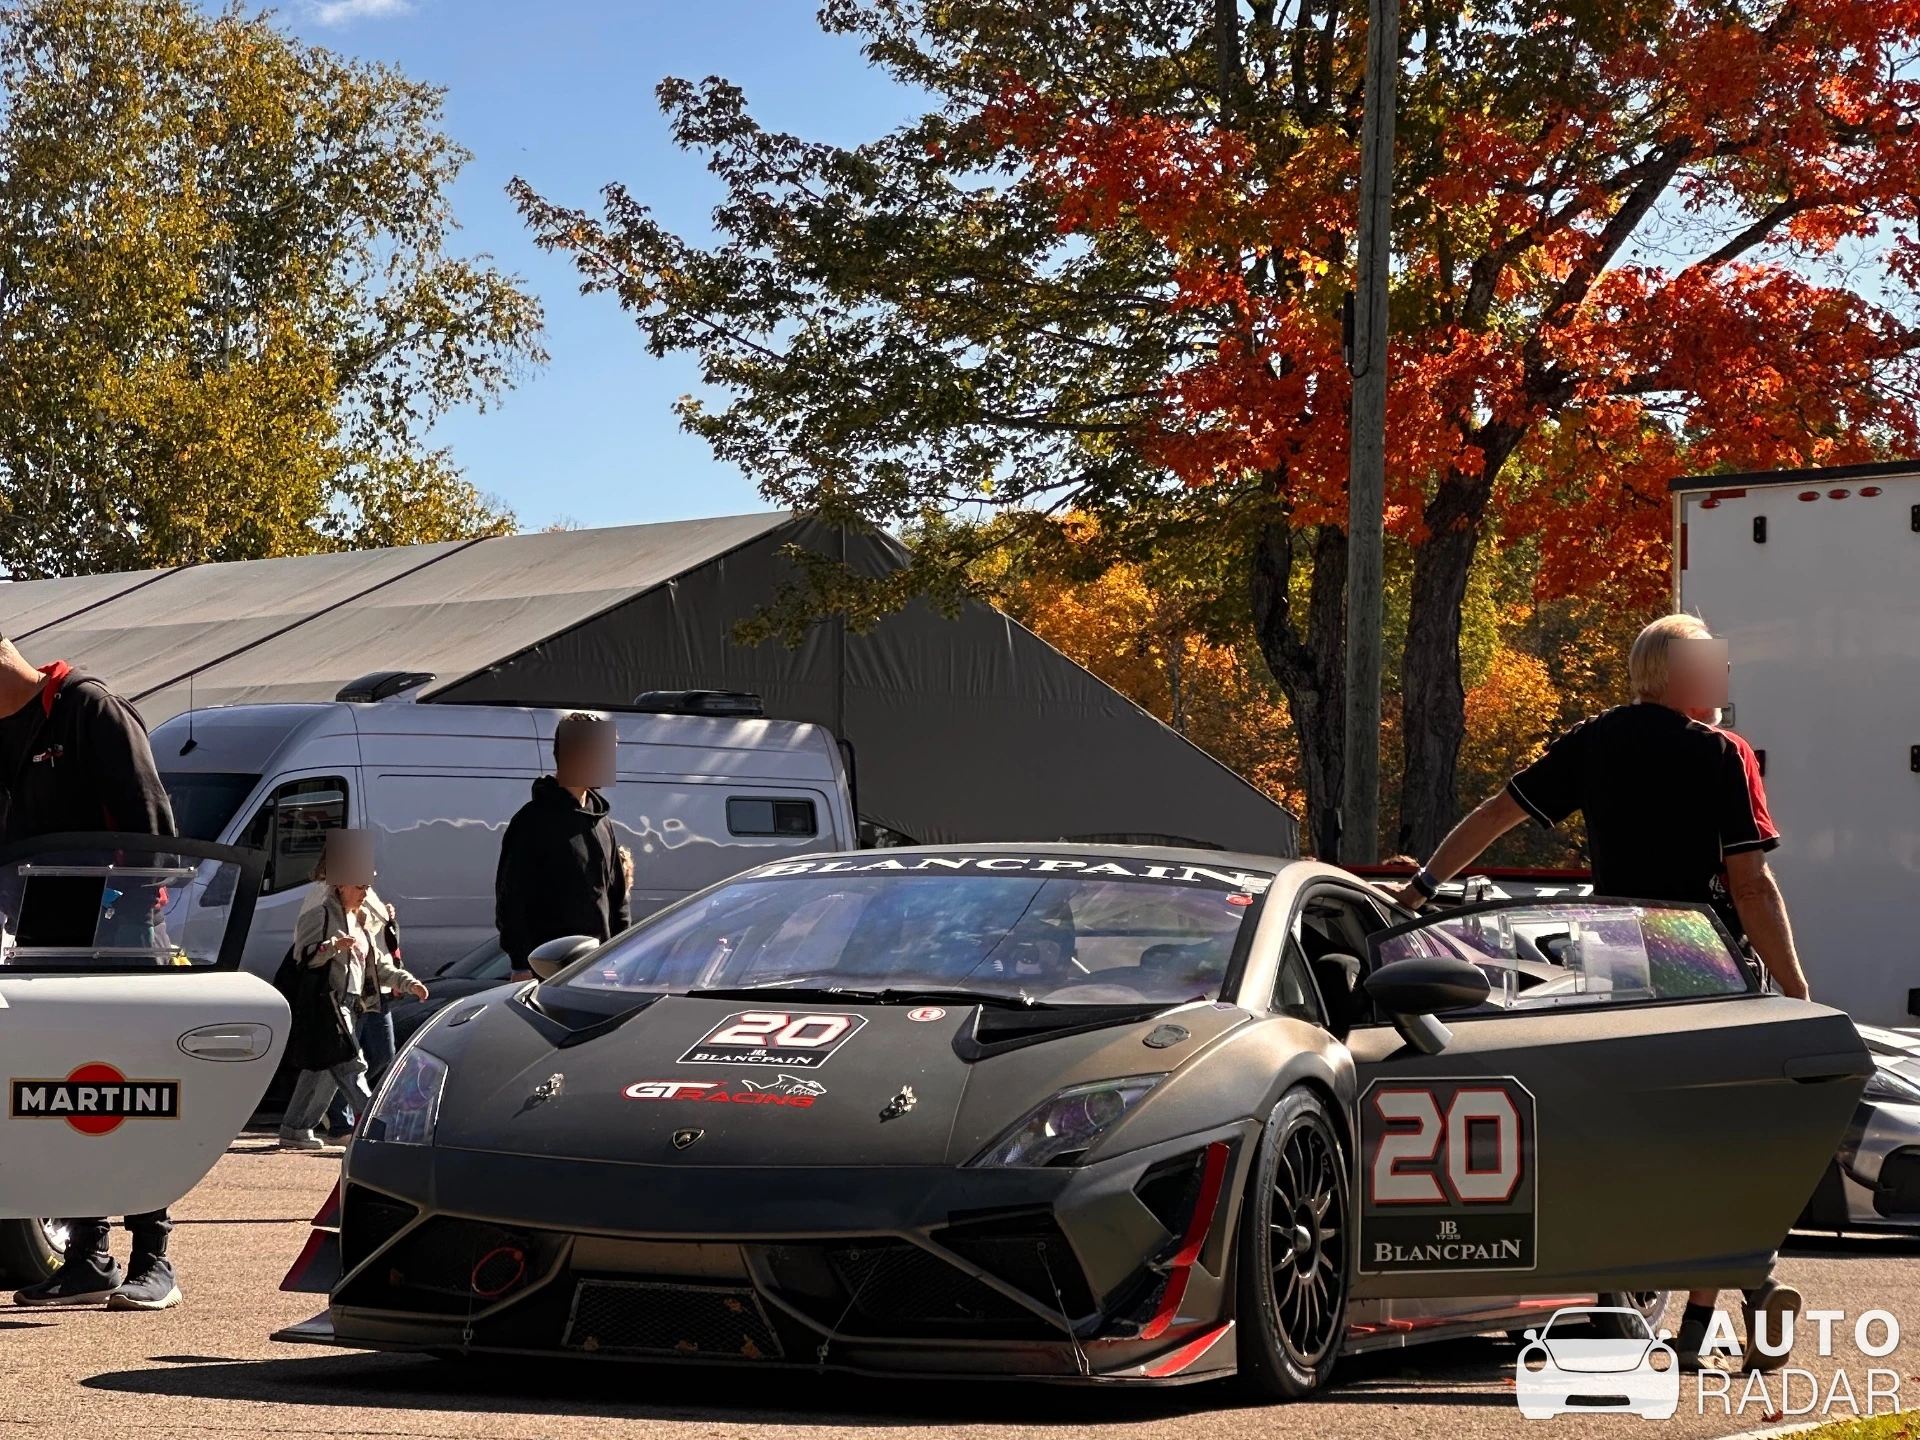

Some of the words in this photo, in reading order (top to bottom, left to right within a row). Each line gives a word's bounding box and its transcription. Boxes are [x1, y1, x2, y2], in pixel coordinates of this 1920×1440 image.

[746, 857, 1255, 888] BLANCPAIN
[707, 1012, 852, 1048] 20
[691, 1053, 814, 1065] BLANCPAIN
[21, 1087, 170, 1111] MARTINI
[1371, 1087, 1525, 1204] 20
[1373, 1239, 1522, 1262] BLANCPAIN
